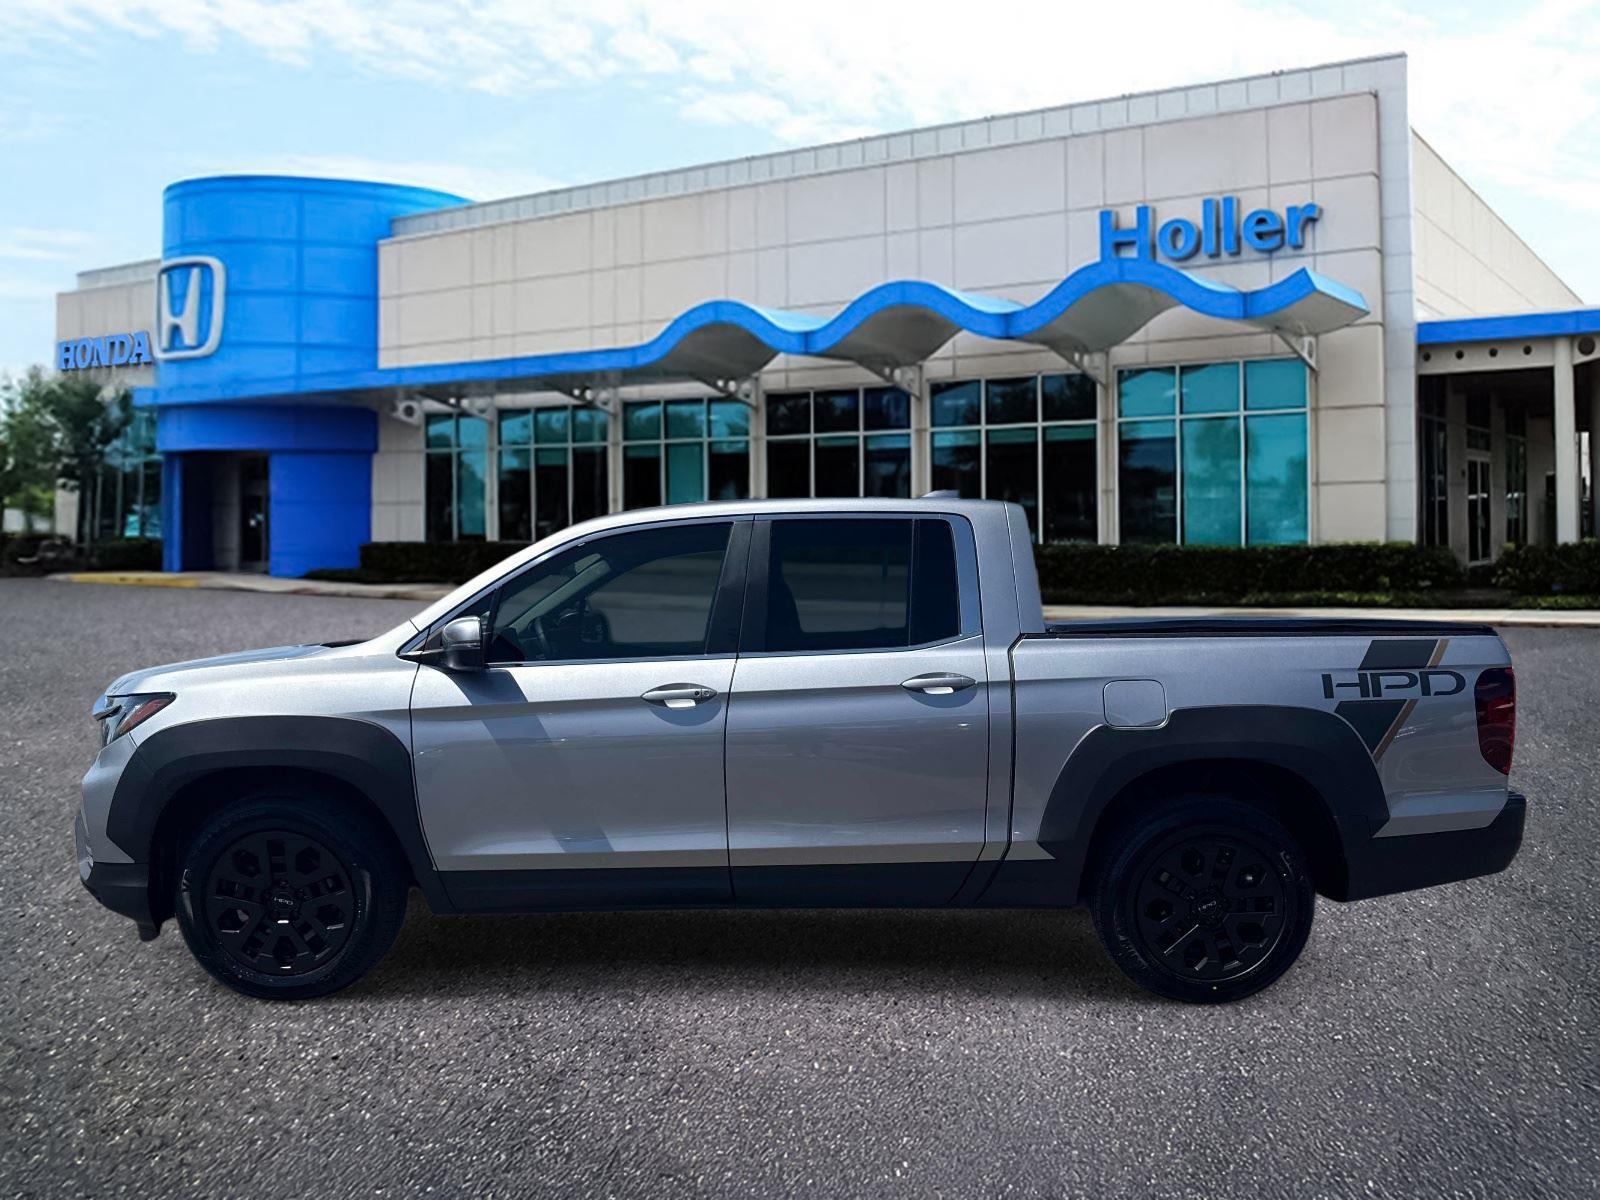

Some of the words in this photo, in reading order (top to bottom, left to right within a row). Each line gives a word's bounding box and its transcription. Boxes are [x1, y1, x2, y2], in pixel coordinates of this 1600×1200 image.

[1098, 195, 1321, 261] Holler
[57, 331, 152, 371] HONDA
[1321, 670, 1467, 699] HPD
